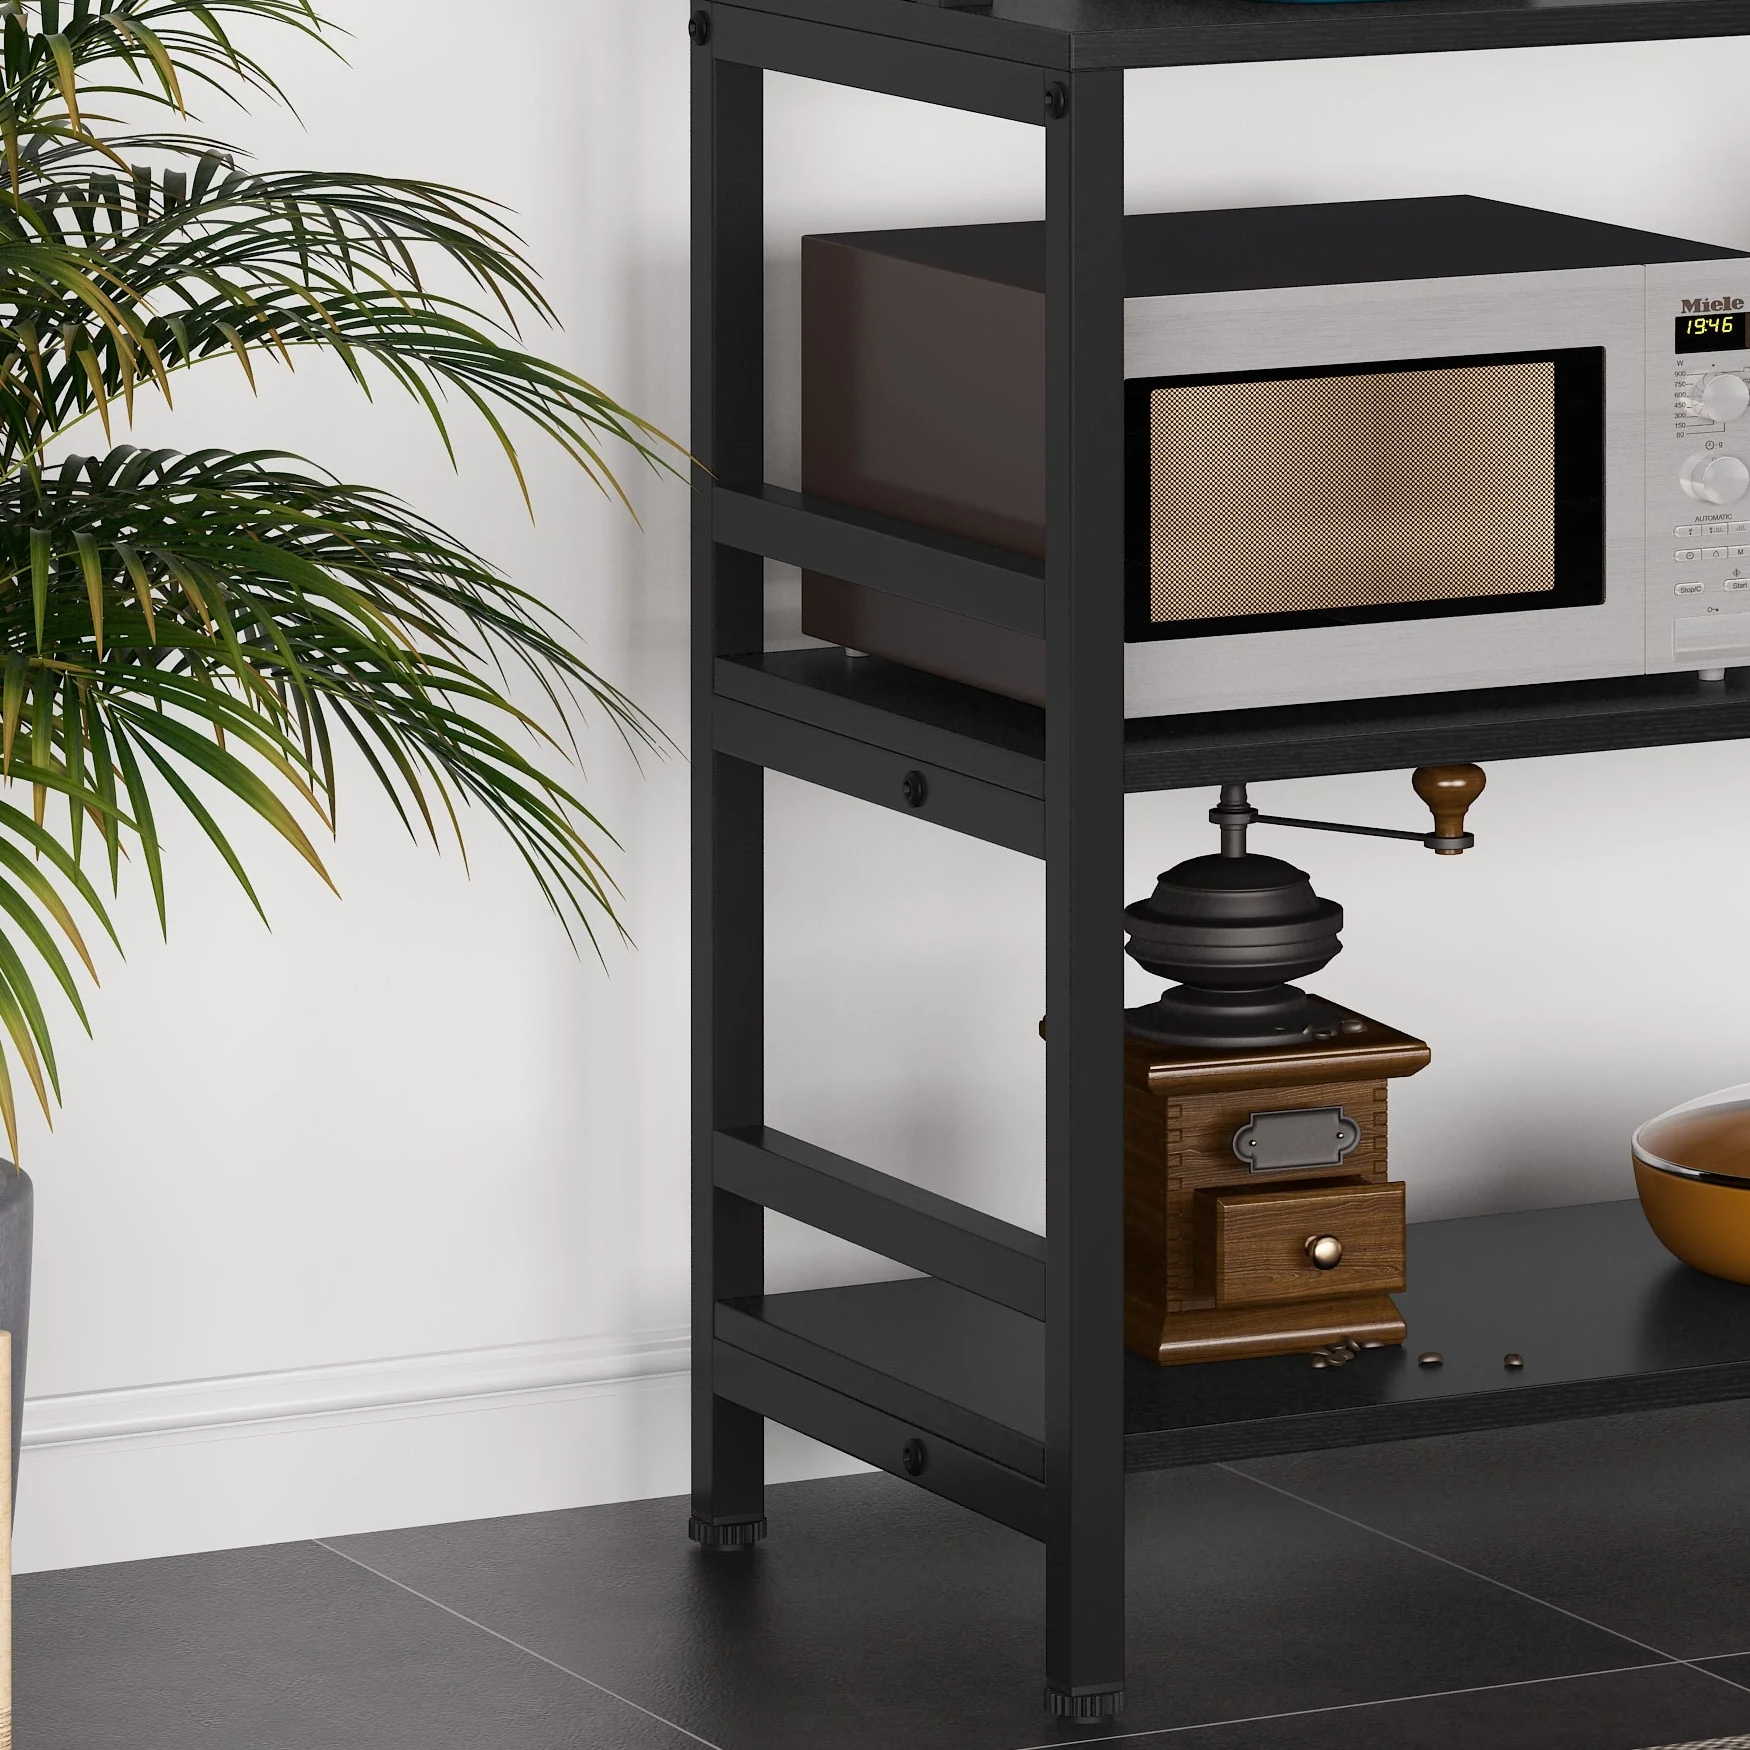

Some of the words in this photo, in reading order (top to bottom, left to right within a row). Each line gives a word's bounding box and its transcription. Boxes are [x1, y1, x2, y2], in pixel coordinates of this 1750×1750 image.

[1681, 296, 1744, 313] Miele
[1687, 316, 1733, 334] 19:46
[1694, 514, 1732, 522] AUTOMATIC
[1680, 586, 1701, 594] Stop/C
